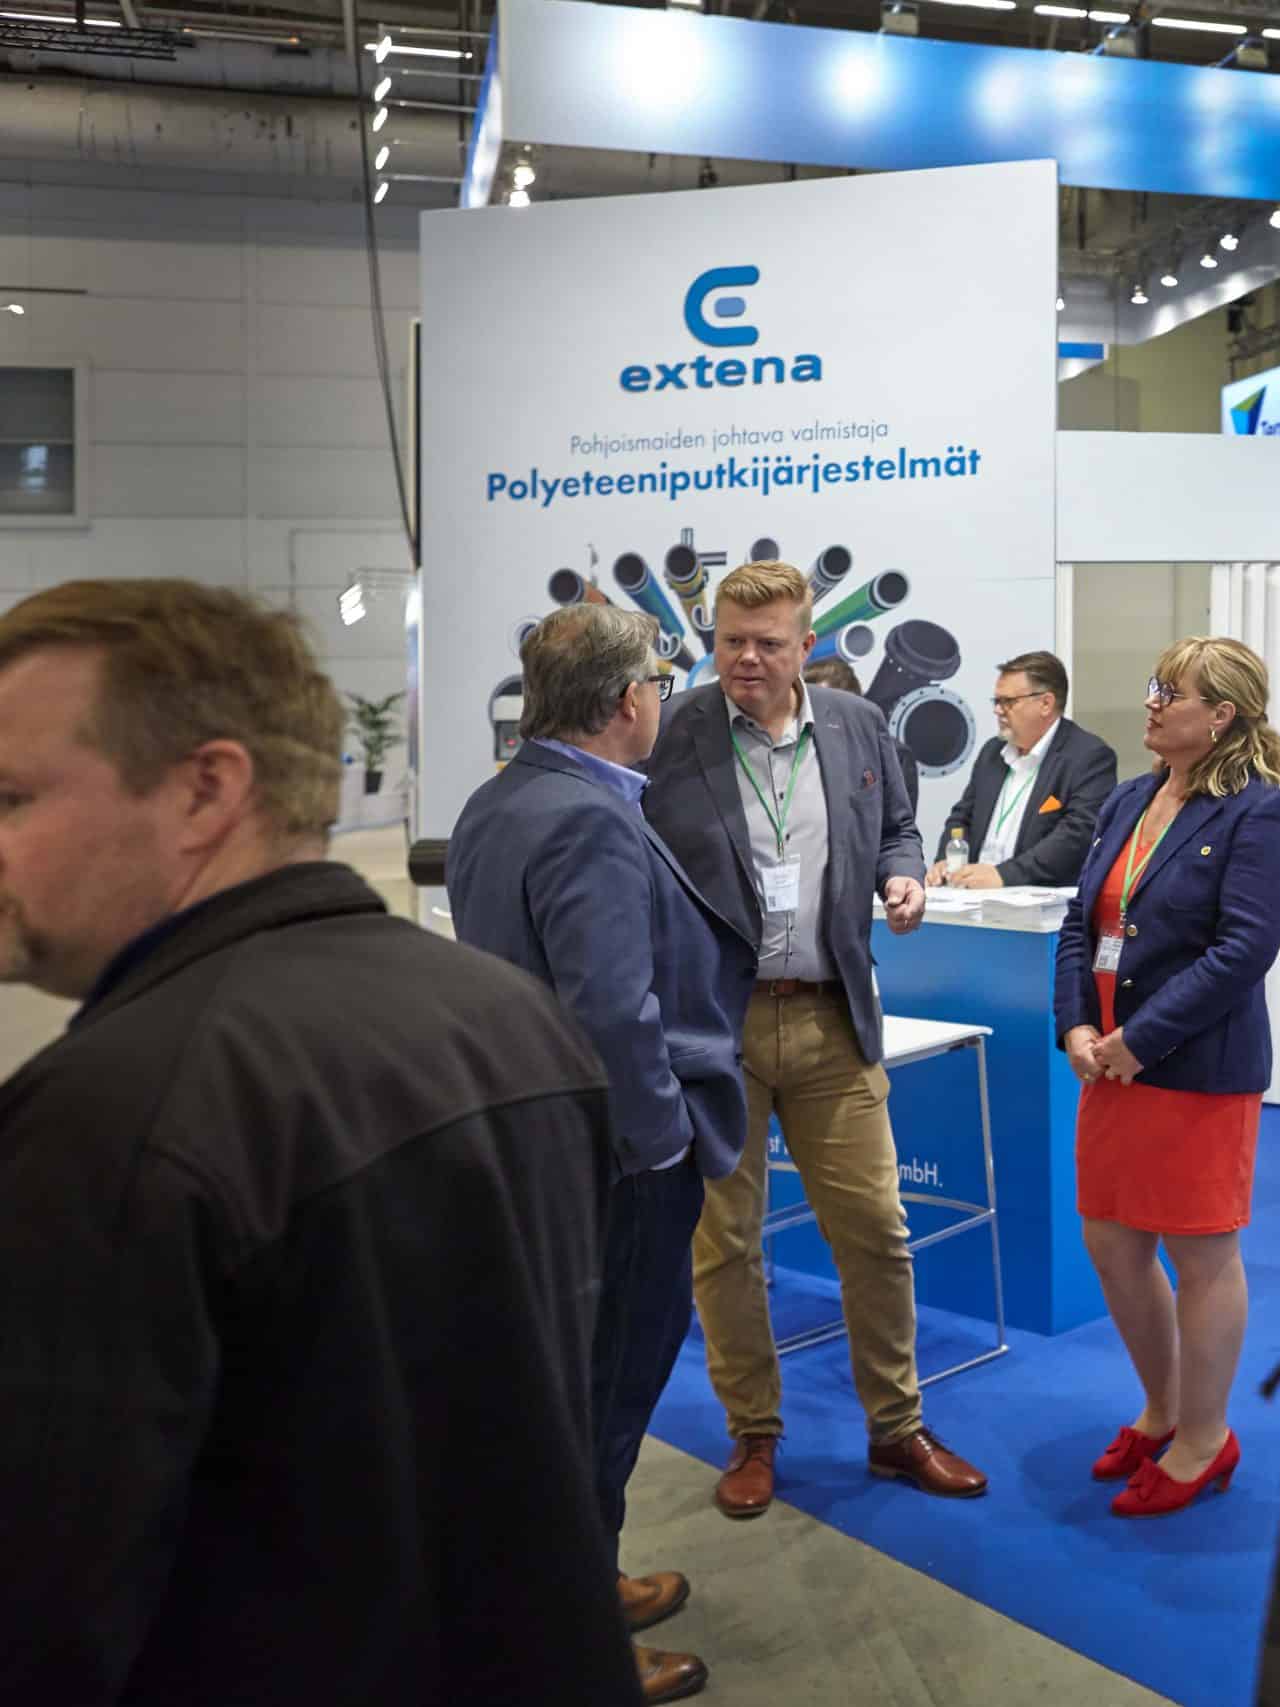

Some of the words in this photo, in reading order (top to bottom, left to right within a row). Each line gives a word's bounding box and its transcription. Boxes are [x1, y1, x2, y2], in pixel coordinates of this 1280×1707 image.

[619, 352, 824, 392] extena
[570, 427, 705, 458] Pohjoismaiden
[711, 423, 784, 452] johtava
[791, 419, 889, 443] valmistaja
[486, 447, 982, 508] Polyeteeniputkijärjestelmät
